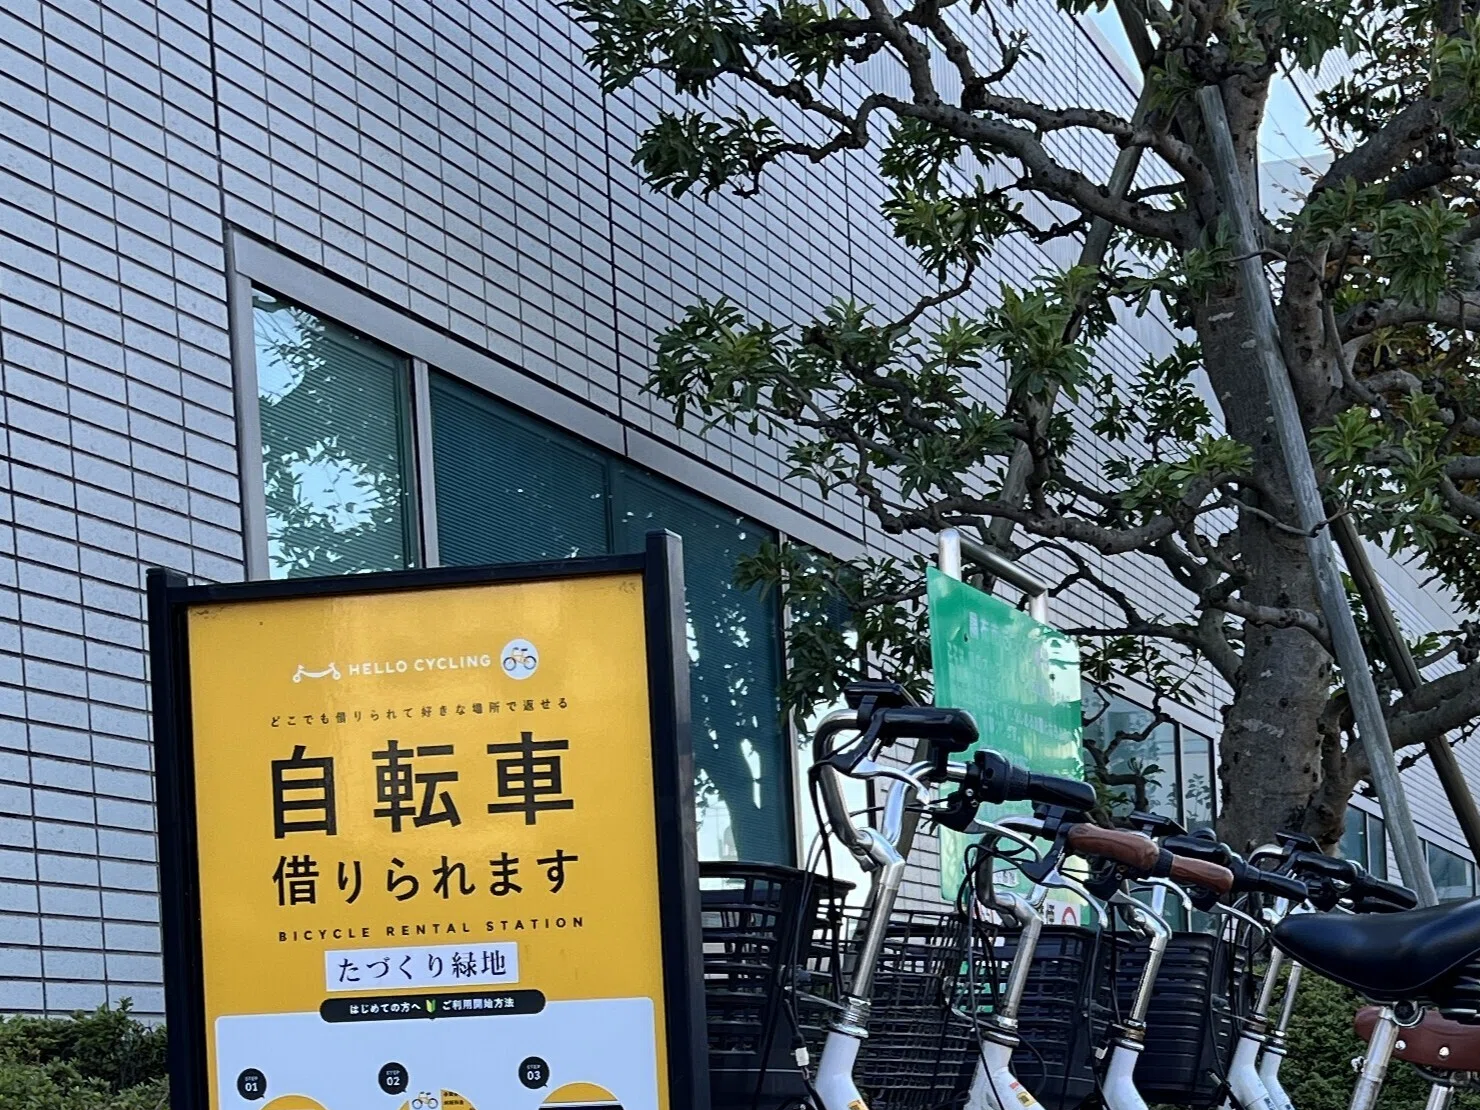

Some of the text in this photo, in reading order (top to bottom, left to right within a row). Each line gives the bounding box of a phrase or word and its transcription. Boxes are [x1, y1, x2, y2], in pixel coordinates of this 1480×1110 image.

[349, 654, 491, 676] HELLO CYCLING
[270, 697, 568, 728] どこでも借りられて好きな場所で返せる
[271, 731, 574, 839] 自転車
[272, 849, 579, 907] 借りられます
[279, 917, 584, 942] BICYCLE RENTAL STATION
[338, 950, 507, 983] たづくり緑地
[350, 997, 515, 1015] はじめての方へ ご利用開始方法
[245, 1082, 258, 1092] 01
[386, 1076, 400, 1086] 02
[526, 1070, 541, 1081] 03
